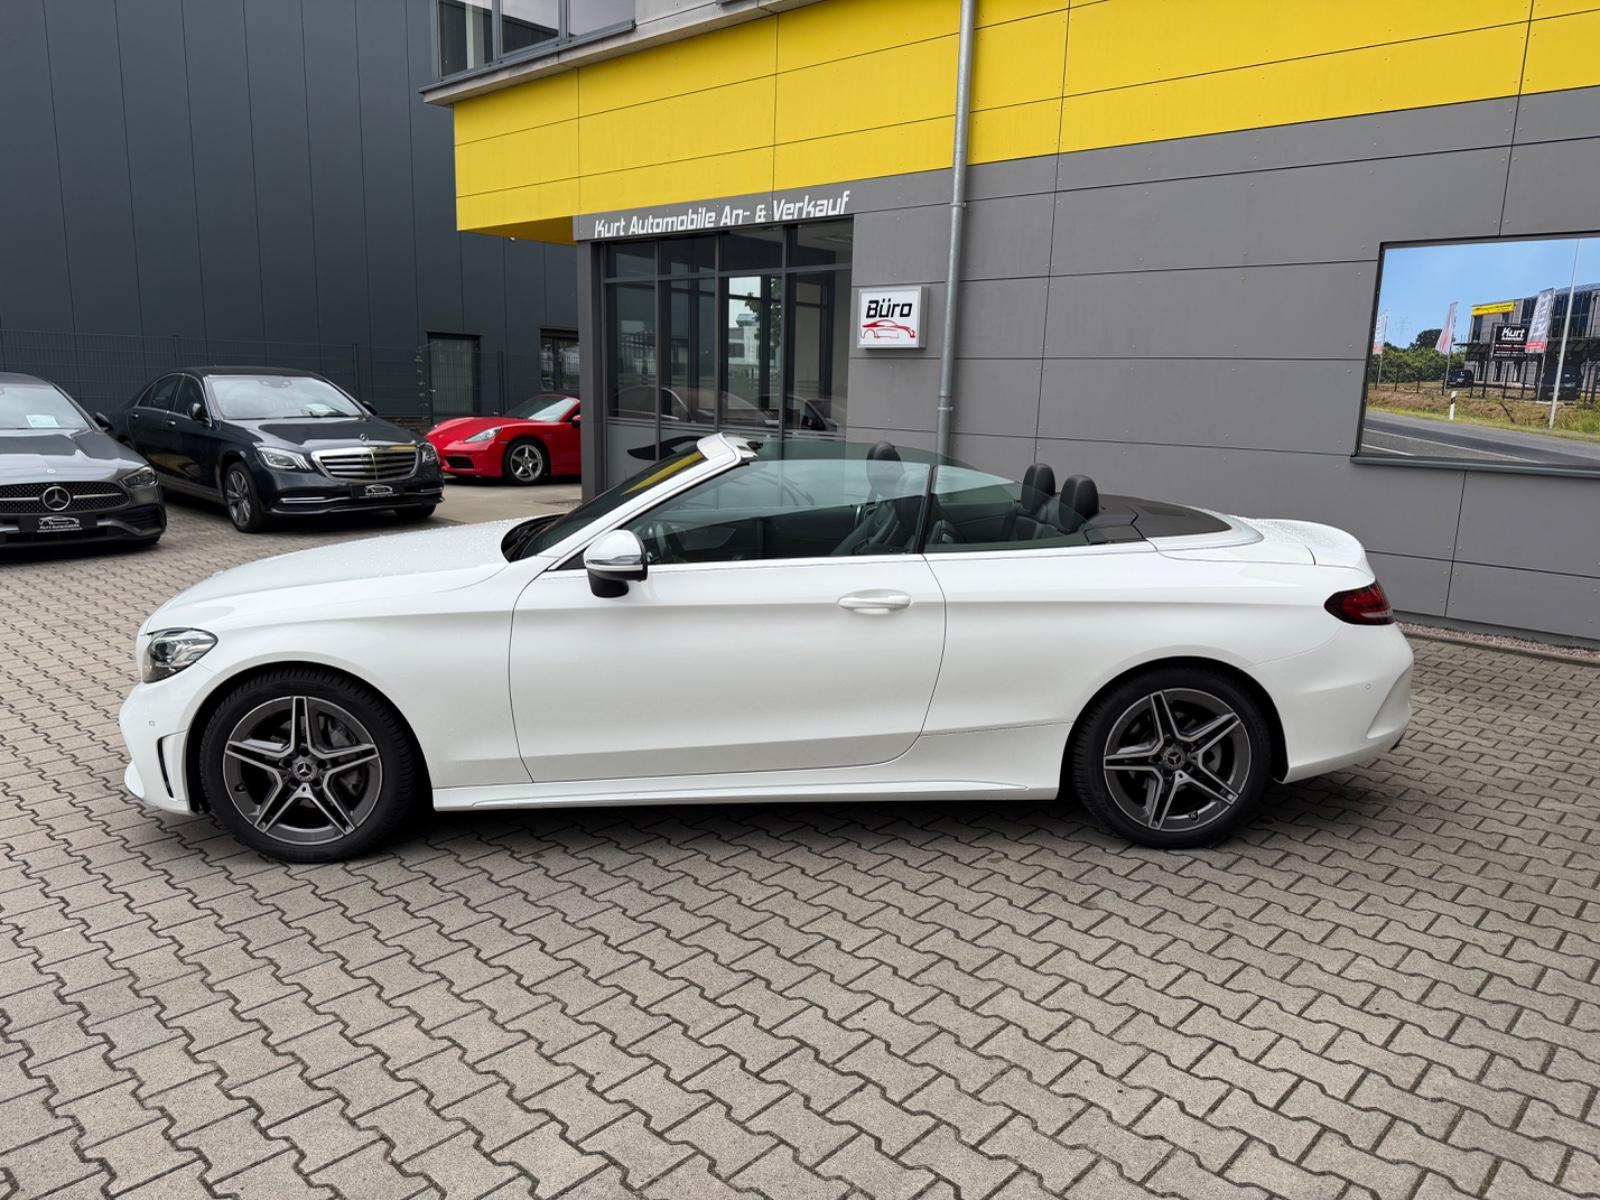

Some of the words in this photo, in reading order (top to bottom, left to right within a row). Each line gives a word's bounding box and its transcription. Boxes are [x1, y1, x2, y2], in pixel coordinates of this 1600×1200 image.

[594, 218, 626, 239] Kurt
[628, 206, 716, 236] Automobile
[720, 204, 751, 226] An-
[755, 203, 766, 223] &
[772, 190, 851, 222] Verkauf
[866, 298, 912, 318] Büro
[1501, 327, 1525, 337] Kurt
